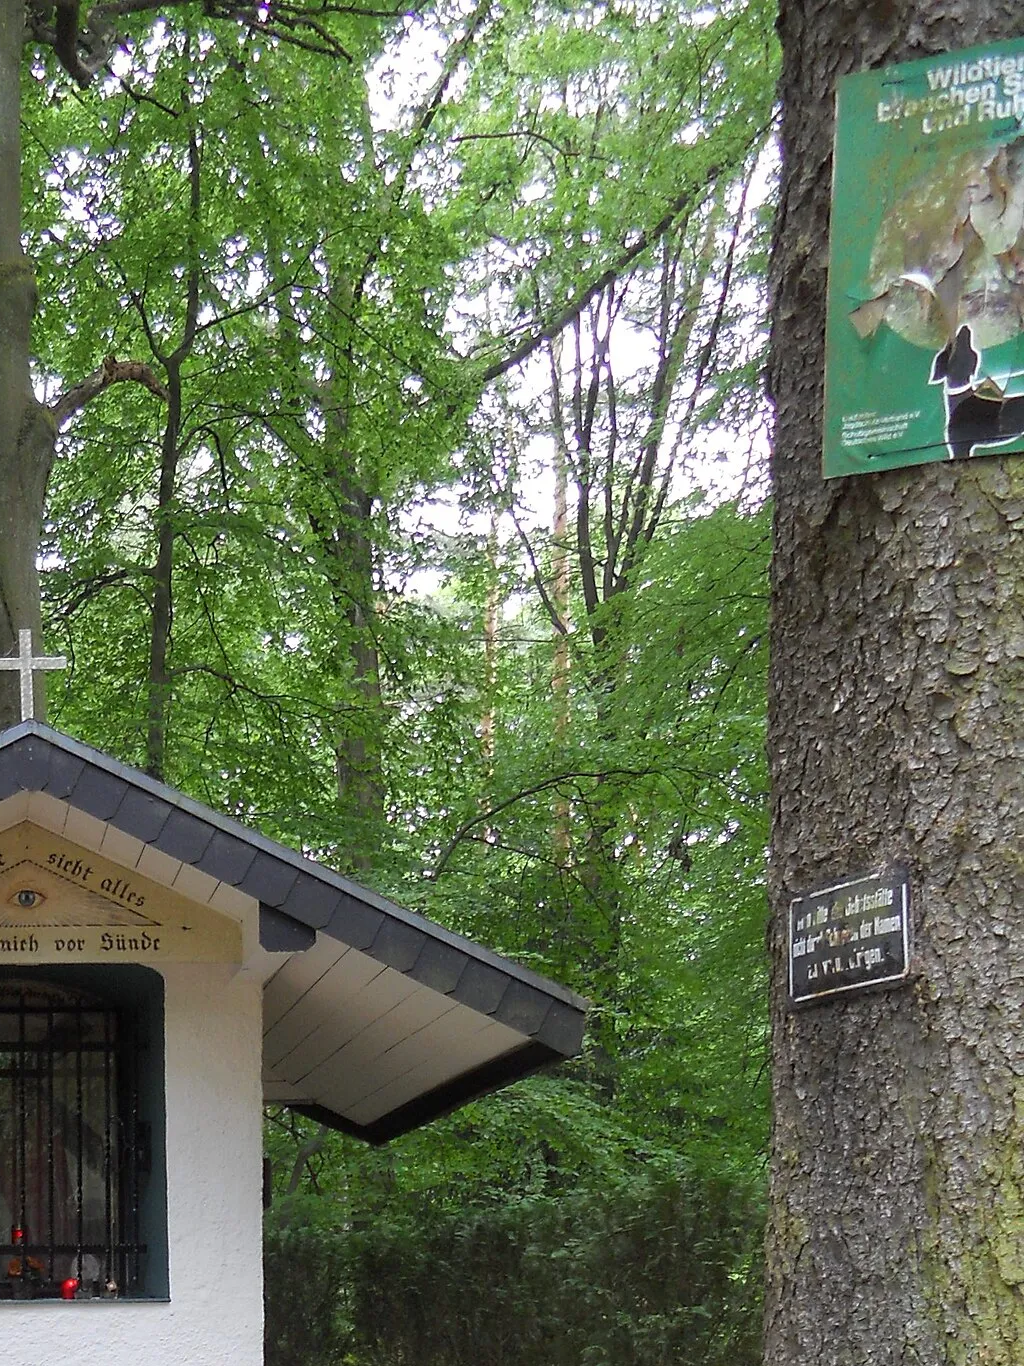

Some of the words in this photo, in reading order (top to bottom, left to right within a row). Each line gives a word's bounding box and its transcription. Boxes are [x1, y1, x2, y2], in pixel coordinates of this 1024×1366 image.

[47, 853, 94, 881] sieht
[100, 878, 145, 907] alles
[55, 938, 85, 951] vor
[100, 931, 161, 951] Sünde
